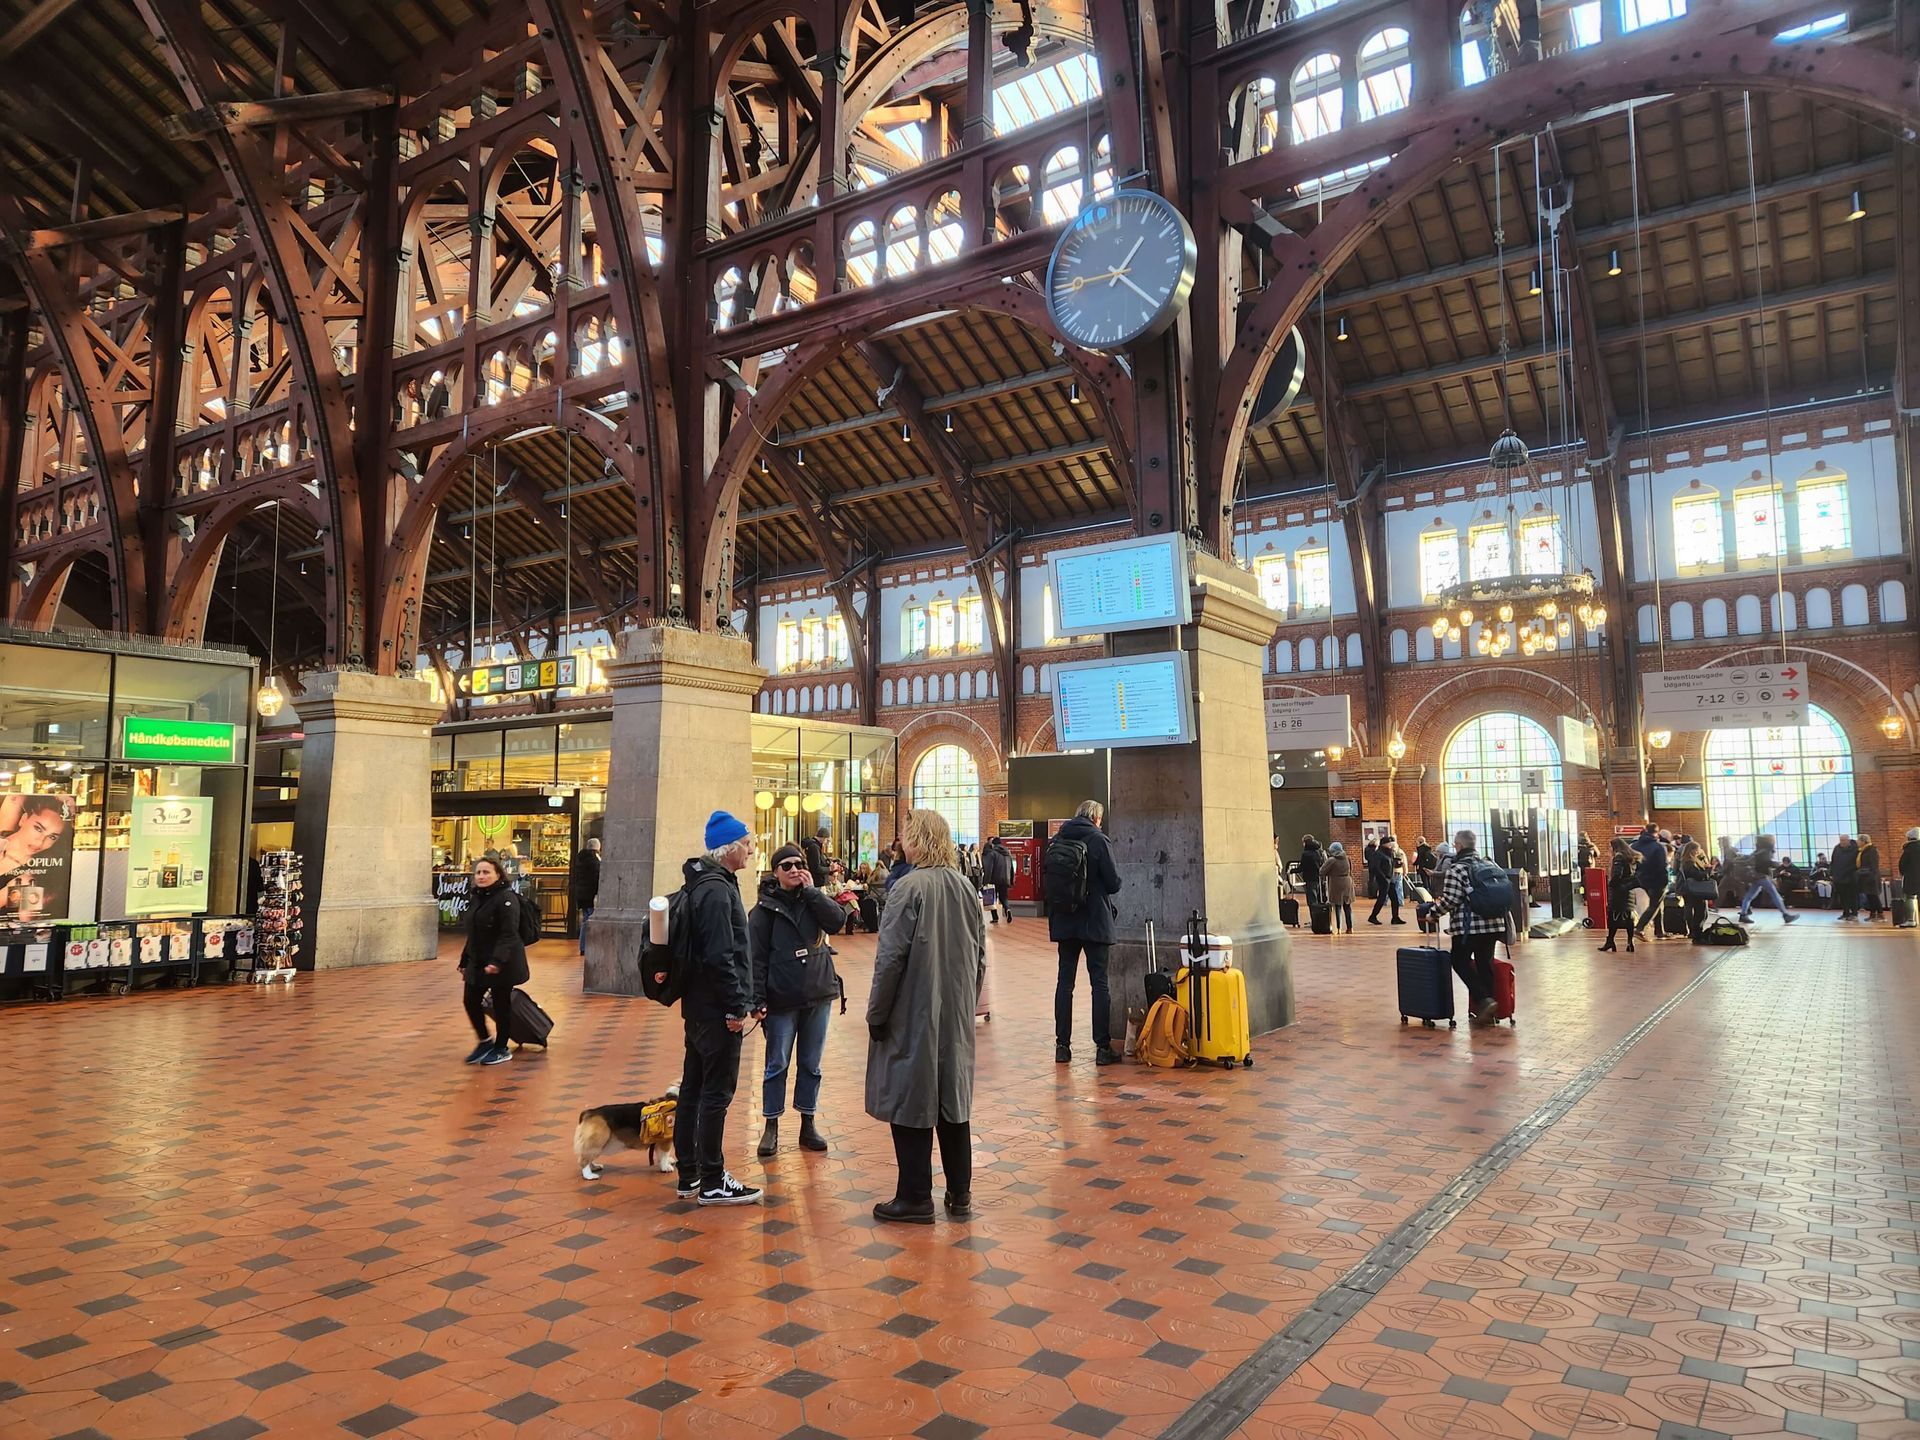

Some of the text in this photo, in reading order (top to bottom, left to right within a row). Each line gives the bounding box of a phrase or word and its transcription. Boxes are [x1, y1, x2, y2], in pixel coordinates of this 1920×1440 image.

[1664, 681, 1691, 689] Udgang
[1696, 694, 1725, 704] 7-12
[1273, 720, 1302, 729] 1-6 26
[129, 732, 230, 748] Håndkøbsmedicin
[152, 807, 167, 825] 3
[179, 807, 192, 825] 2
[27, 857, 63, 868] OPIUM
[437, 873, 469, 896] Sweet
